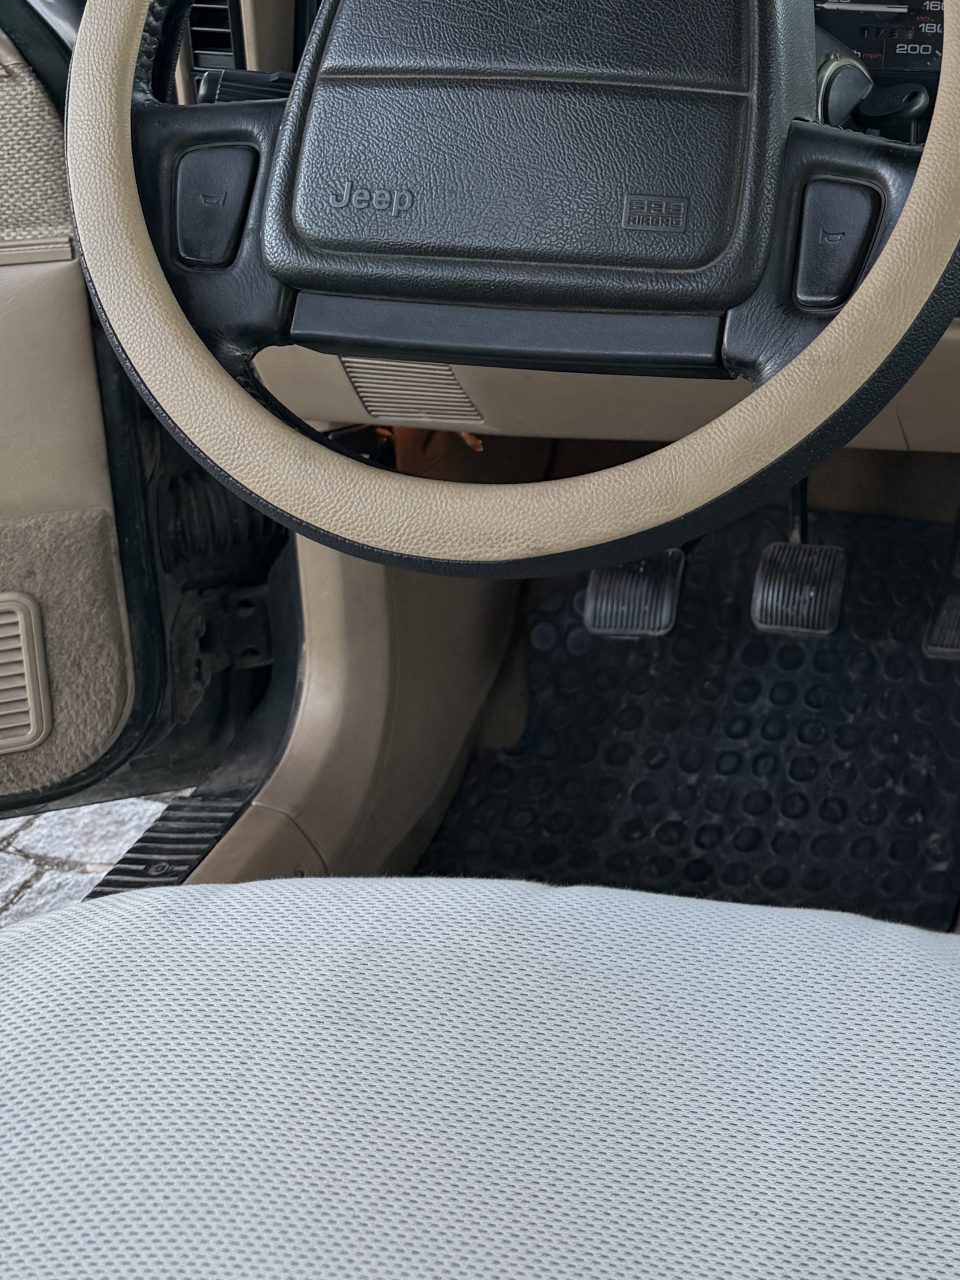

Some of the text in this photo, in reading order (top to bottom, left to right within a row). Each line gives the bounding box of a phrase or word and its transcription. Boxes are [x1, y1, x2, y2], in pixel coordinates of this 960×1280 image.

[922, 1, 945, 12] 16
[895, 43, 932, 55] 200
[329, 180, 415, 219] Jeep
